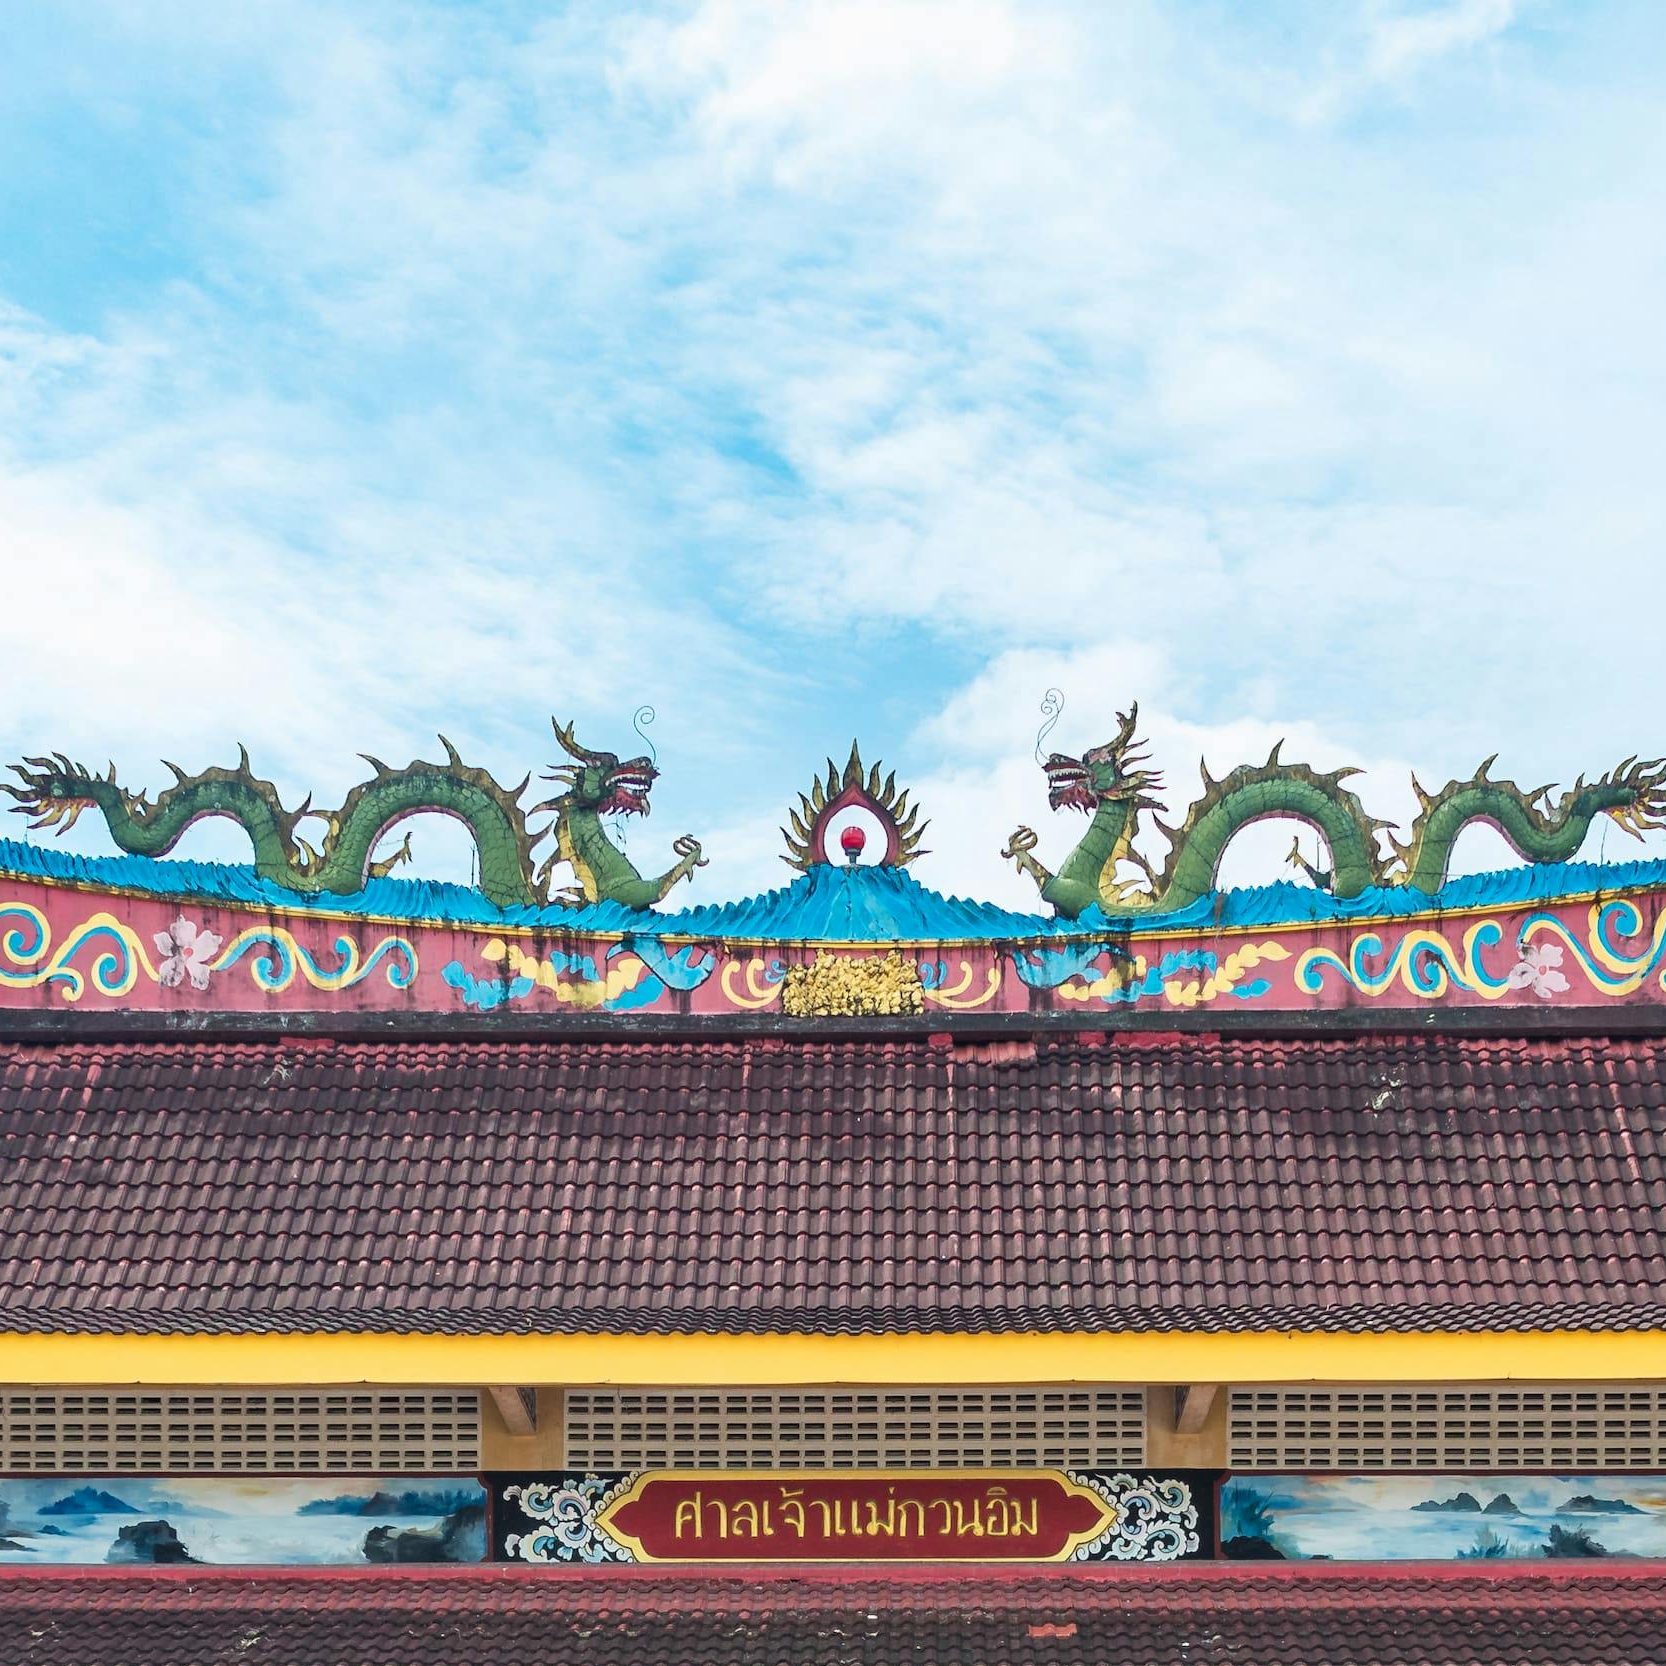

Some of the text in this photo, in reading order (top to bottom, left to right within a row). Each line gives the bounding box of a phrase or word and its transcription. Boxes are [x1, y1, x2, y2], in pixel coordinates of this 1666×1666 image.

[673, 1485, 1039, 1538] ศาลเจ้าแม่กวนอิม
